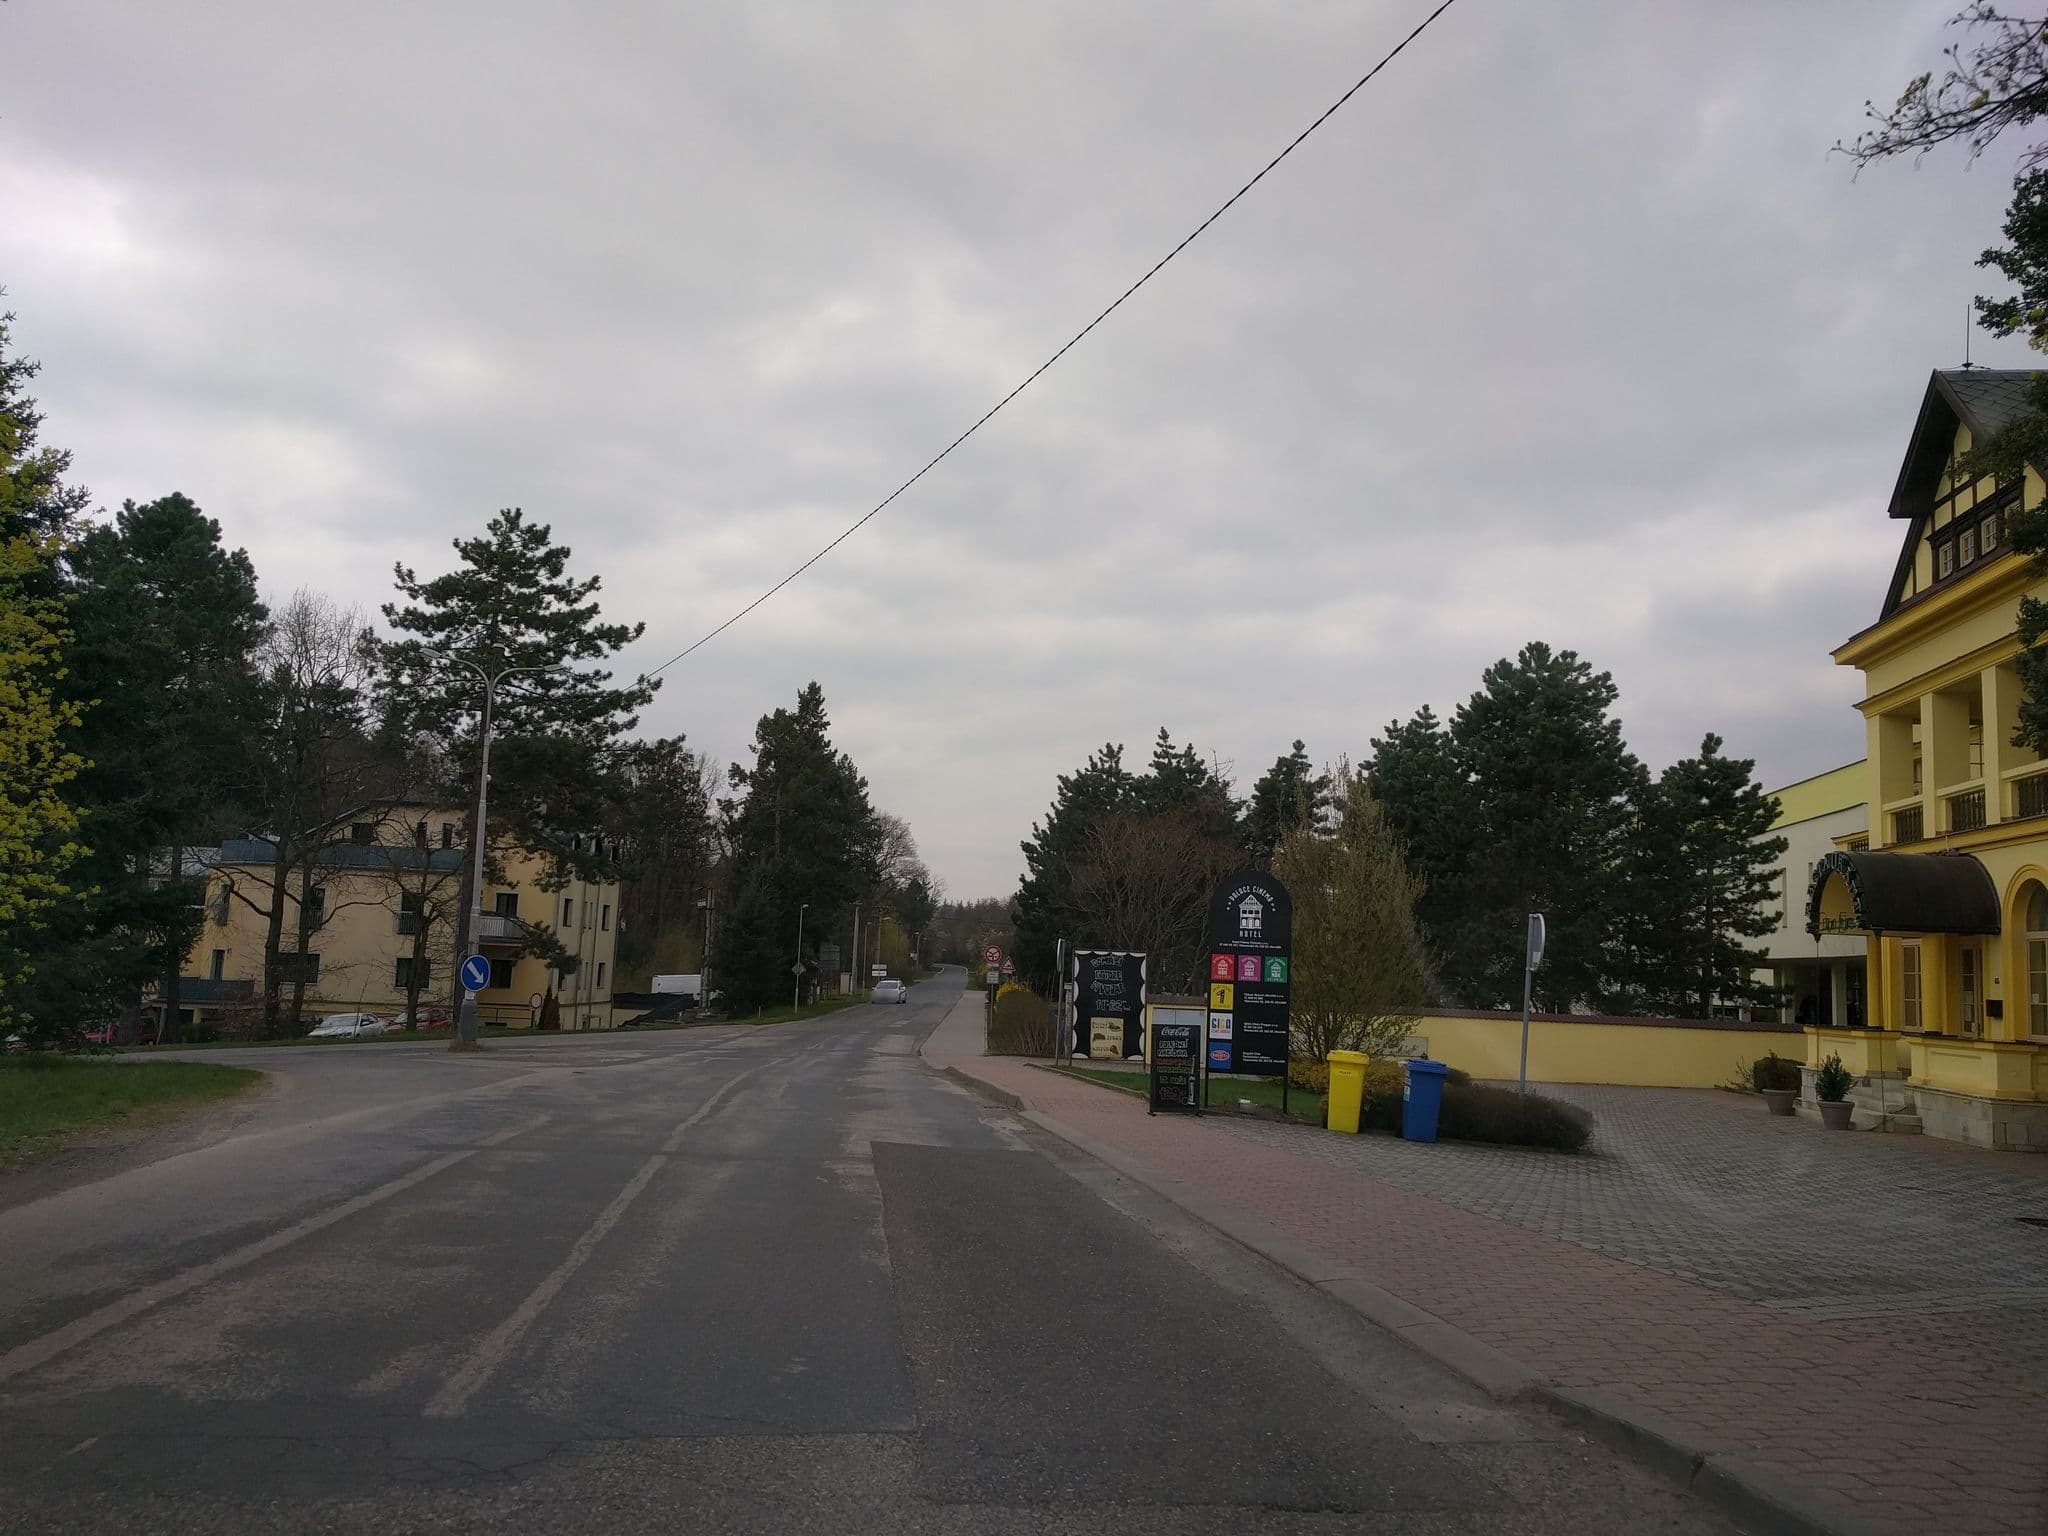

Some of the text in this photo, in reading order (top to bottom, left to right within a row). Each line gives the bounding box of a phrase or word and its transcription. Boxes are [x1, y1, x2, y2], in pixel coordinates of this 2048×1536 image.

[1229, 885, 1275, 903] PALACE CINEMA
[1239, 930, 1262, 938] HOTEL
